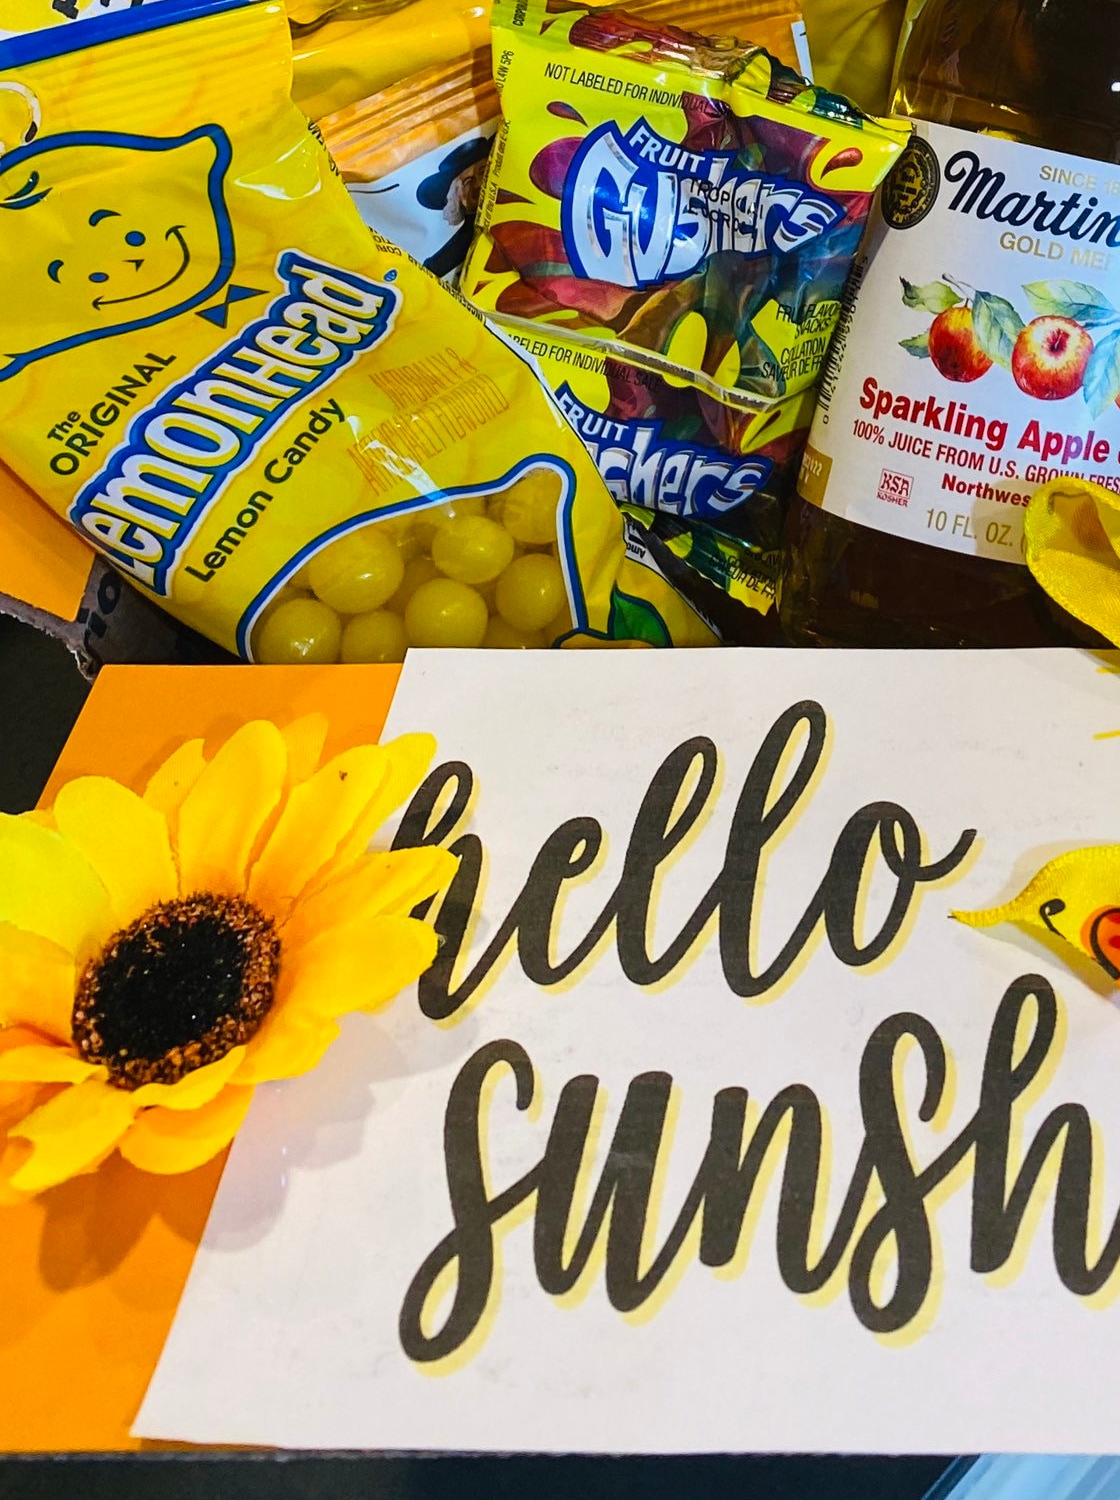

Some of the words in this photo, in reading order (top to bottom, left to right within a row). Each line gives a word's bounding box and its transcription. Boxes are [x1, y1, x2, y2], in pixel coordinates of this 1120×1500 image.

[544, 62, 571, 82] NOT
[570, 68, 623, 96] LABELED
[623, 82, 648, 101] FOR
[629, 125, 705, 173] FRUIT
[1039, 165, 1097, 191] SINCE
[999, 231, 1065, 262] GOLD
[548, 345, 573, 365] FOR
[572, 350, 631, 384] INDIVIDUAL
[47, 410, 81, 443] The
[50, 351, 178, 477] ORIGINAL
[557, 392, 630, 442] FRUIT
[859, 376, 1009, 452] Sparkling
[1017, 419, 1111, 465] Apple
[853, 419, 886, 446] 100%
[888, 431, 933, 459] JUICE
[935, 443, 985, 472] FROM
[989, 457, 1020, 480] U.S.
[184, 489, 275, 583] Lemon
[263, 397, 348, 485] Candy
[876, 491, 909, 508] KOSHER
[926, 507, 948, 532] 10
[951, 514, 978, 540] FL.
[985, 521, 1014, 547] OZ.
[390, 699, 978, 1020] hello
